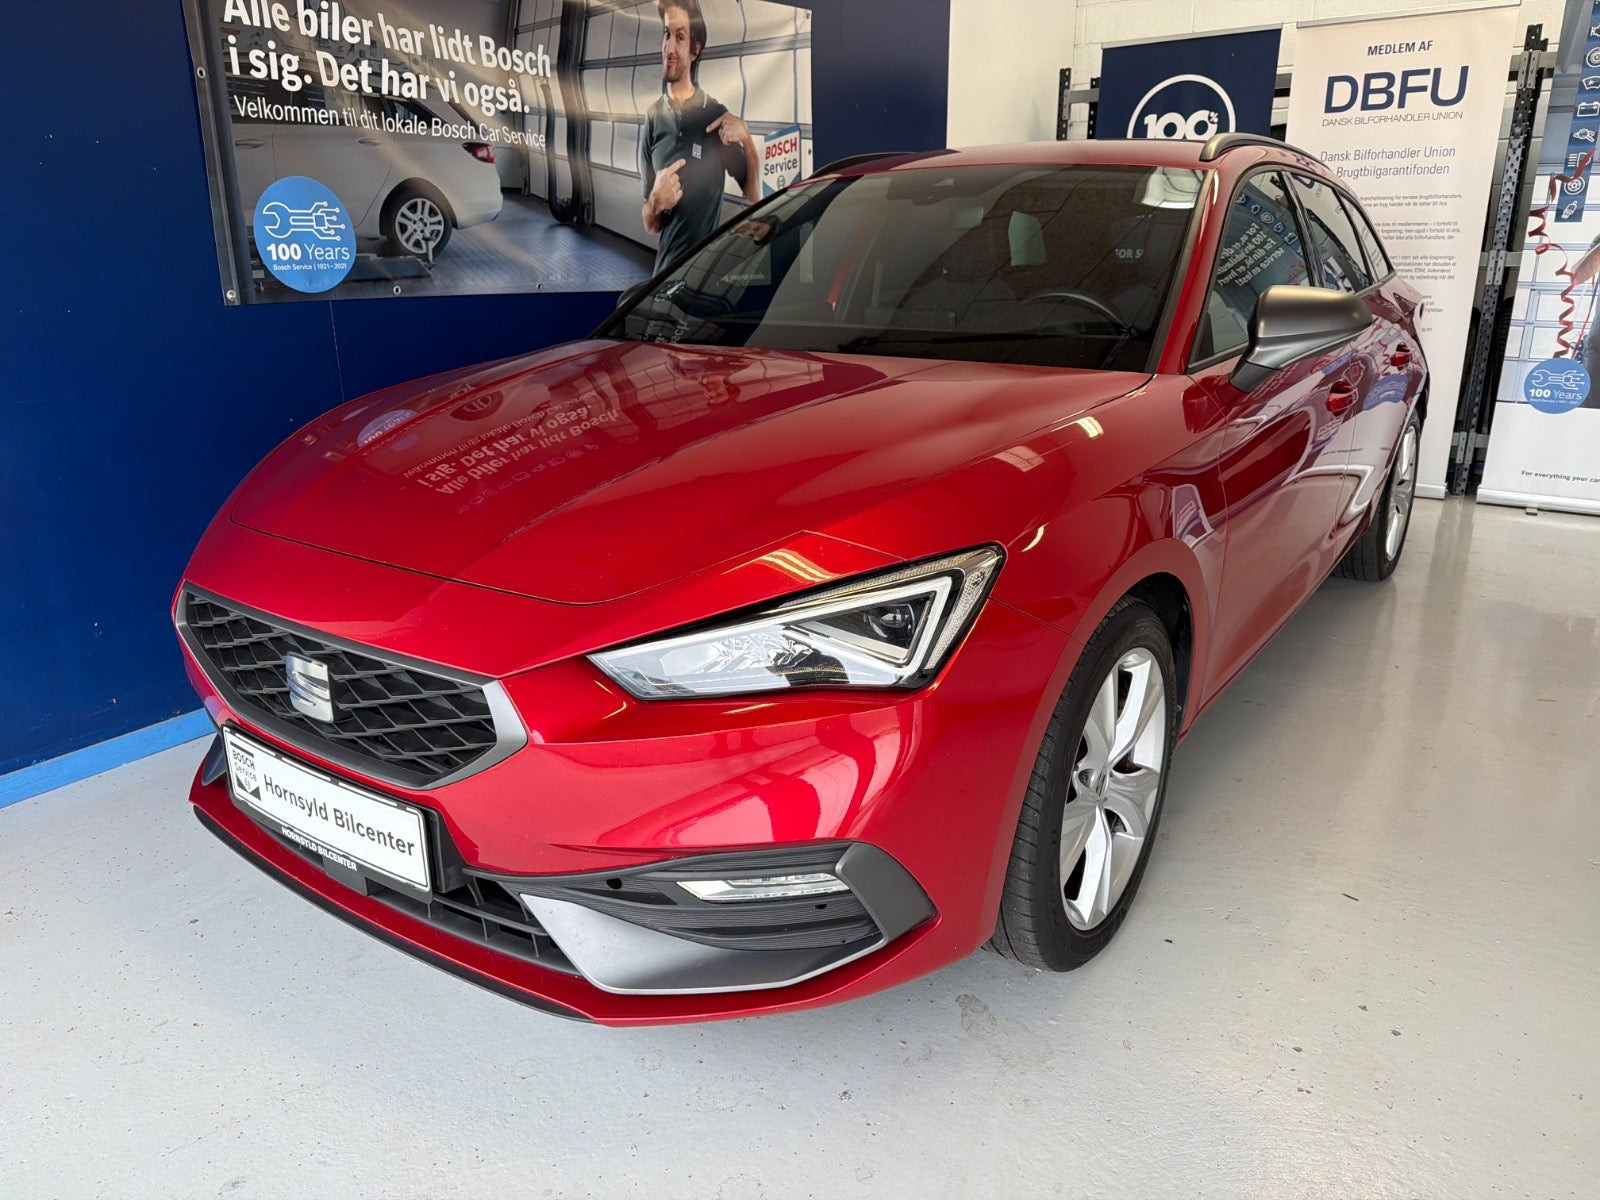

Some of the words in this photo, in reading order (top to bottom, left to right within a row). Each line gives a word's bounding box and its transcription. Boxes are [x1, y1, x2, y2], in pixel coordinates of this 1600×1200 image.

[224, 0, 291, 32] Alle
[296, 0, 374, 46] biler
[378, 13, 424, 56] har
[429, 24, 477, 65] lidt
[479, 34, 551, 77] Bosch
[1367, 42, 1415, 56] MEDLEM
[1418, 40, 1433, 52] AF
[228, 35, 240, 75] i
[250, 40, 312, 92] sig.
[316, 50, 373, 94] Det
[381, 58, 430, 100] har
[434, 70, 460, 104] vi
[464, 78, 530, 117] også.
[1324, 66, 1469, 114] DBFU
[234, 95, 339, 126] Velkommen
[342, 107, 358, 127] til
[360, 111, 380, 131] dit
[382, 112, 427, 136] lokale
[432, 118, 476, 140] Bosch
[479, 123, 500, 142] Car
[502, 127, 546, 148] Service
[1322, 118, 1352, 126] DANSK
[1354, 112, 1430, 125] BILFORHANDLER
[1432, 111, 1463, 121] UNION
[765, 137, 798, 160] BOSCH
[1320, 150, 1351, 162] Dansk
[1354, 147, 1422, 161] Bilforhandler
[1424, 146, 1456, 158] Union
[764, 158, 798, 176] Service
[1336, 164, 1449, 180] Brugtbilgarantifonden
[267, 243, 302, 260] 100
[304, 243, 350, 260] Years
[1529, 388, 1551, 398] 100
[1552, 390, 1582, 400] Years
[1534, 472, 1571, 481] everything
[232, 750, 255, 770] BOSCH
[264, 774, 329, 821] Hornsyld
[333, 808, 415, 856] Bilcenter
[281, 826, 318, 852] HORNSYLD
[318, 846, 357, 872] BILCENTER
